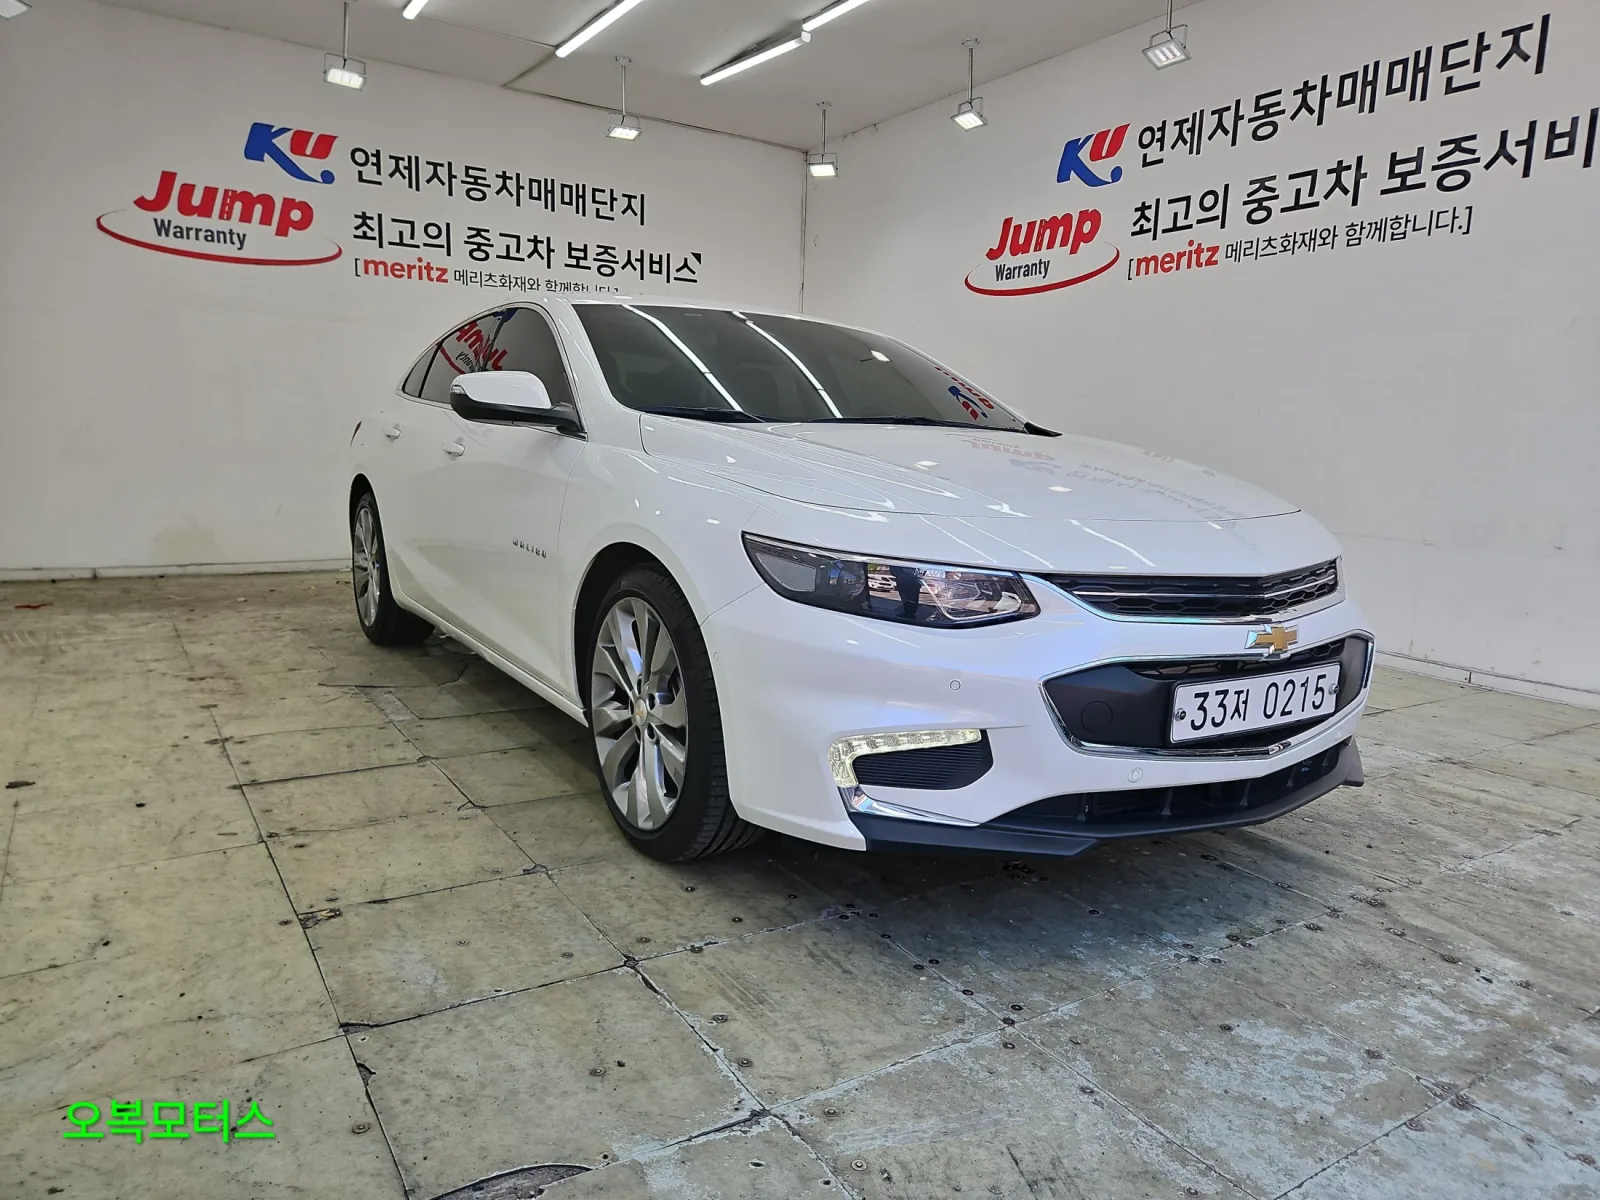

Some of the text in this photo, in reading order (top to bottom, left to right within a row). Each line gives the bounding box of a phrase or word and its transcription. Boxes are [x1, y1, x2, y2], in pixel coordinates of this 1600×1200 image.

[1138, 13, 1551, 168] 연제자동차매매단지
[133, 170, 315, 238] Jump
[350, 147, 646, 226] 연제자동차매매단지
[1130, 183, 1230, 241] 최고의
[1242, 155, 1368, 226] 중고차
[153, 217, 248, 251] Warranty
[352, 211, 699, 284] 최고의 중고차 보증서비스
[985, 208, 1103, 261] Jump
[1224, 225, 1339, 263] 메리츠화재와
[1344, 205, 1474, 248] 함께합니다.]
[453, 269, 541, 293] 메리츠화재와
[994, 257, 1051, 282] Warranty
[1190, 673, 1327, 731] 33저 0215
